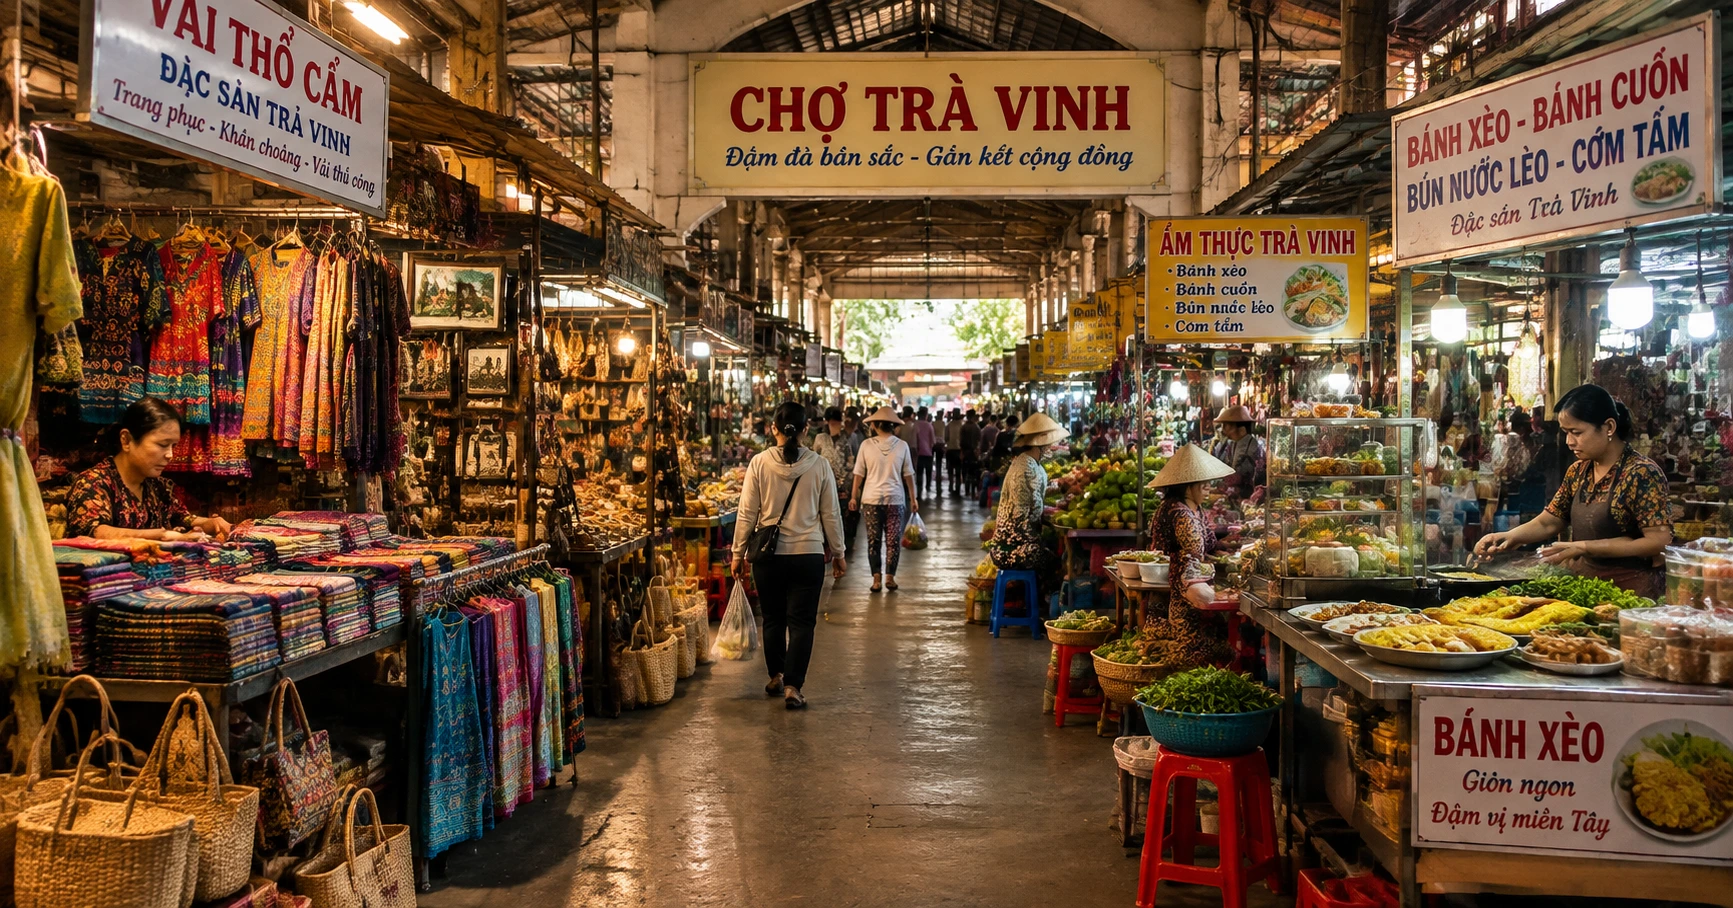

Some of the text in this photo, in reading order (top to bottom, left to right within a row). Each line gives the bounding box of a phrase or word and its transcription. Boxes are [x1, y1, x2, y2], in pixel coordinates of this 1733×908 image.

[229, 17, 294, 88] THỔ
[303, 56, 363, 124] CẨM
[113, 78, 162, 122] Trang
[166, 103, 205, 135] phục
[730, 73, 1130, 143] CHỢ TRÀ VINH
[1408, 122, 1461, 168] BÁNH
[1468, 104, 1510, 152] XÈO
[1517, 119, 1526, 127] -
[1533, 79, 1602, 133] BÁNH
[784, 146, 814, 166] đà
[868, 144, 904, 166] sắc
[979, 144, 1013, 166] kết
[1019, 147, 1071, 172] cộng
[1078, 144, 1133, 172] đồng
[1407, 172, 1443, 213] BÚN
[1510, 145, 1548, 189] LÈO
[1556, 160, 1565, 168] -
[1633, 105, 1690, 159] TẤM
[1571, 182, 1618, 212] Vinh
[1199, 227, 1254, 260] THỰC
[1260, 224, 1301, 255] TRÀ
[1307, 230, 1355, 254] VINH
[1176, 264, 1215, 277] Bánh
[1176, 282, 1215, 295] Bánh
[1434, 707, 1604, 763] BÁNH XÈO
[1519, 779, 1576, 802] ngon
[1431, 801, 1481, 830] Đậm
[1488, 807, 1507, 834] vị
[1571, 810, 1610, 840] Tây
